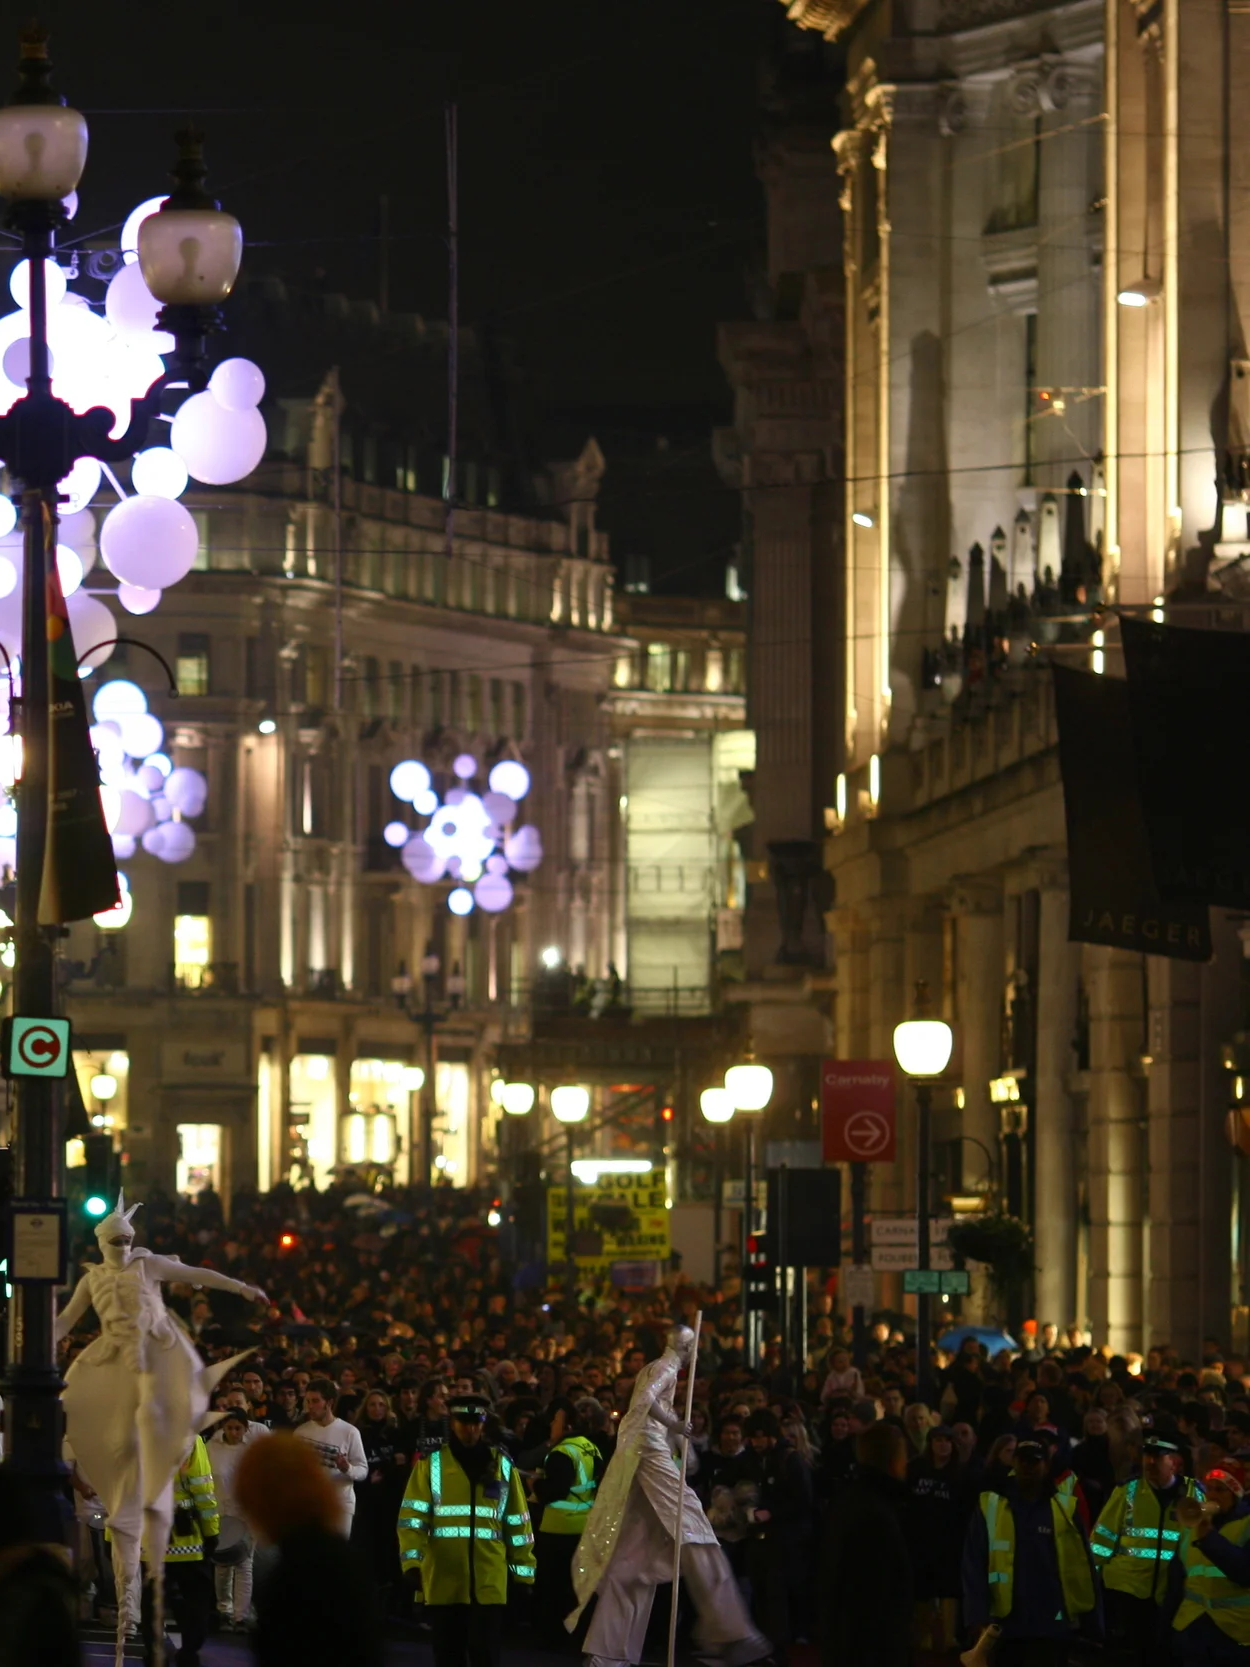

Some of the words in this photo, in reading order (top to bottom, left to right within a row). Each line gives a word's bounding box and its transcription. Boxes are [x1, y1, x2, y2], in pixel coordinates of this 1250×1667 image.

[49, 700, 75, 712] KIA
[1082, 908, 1201, 948] JAEGER
[825, 1073, 890, 1091] Carnaby
[597, 1172, 665, 1190] GOLF
[876, 1226, 917, 1237] CARNA
